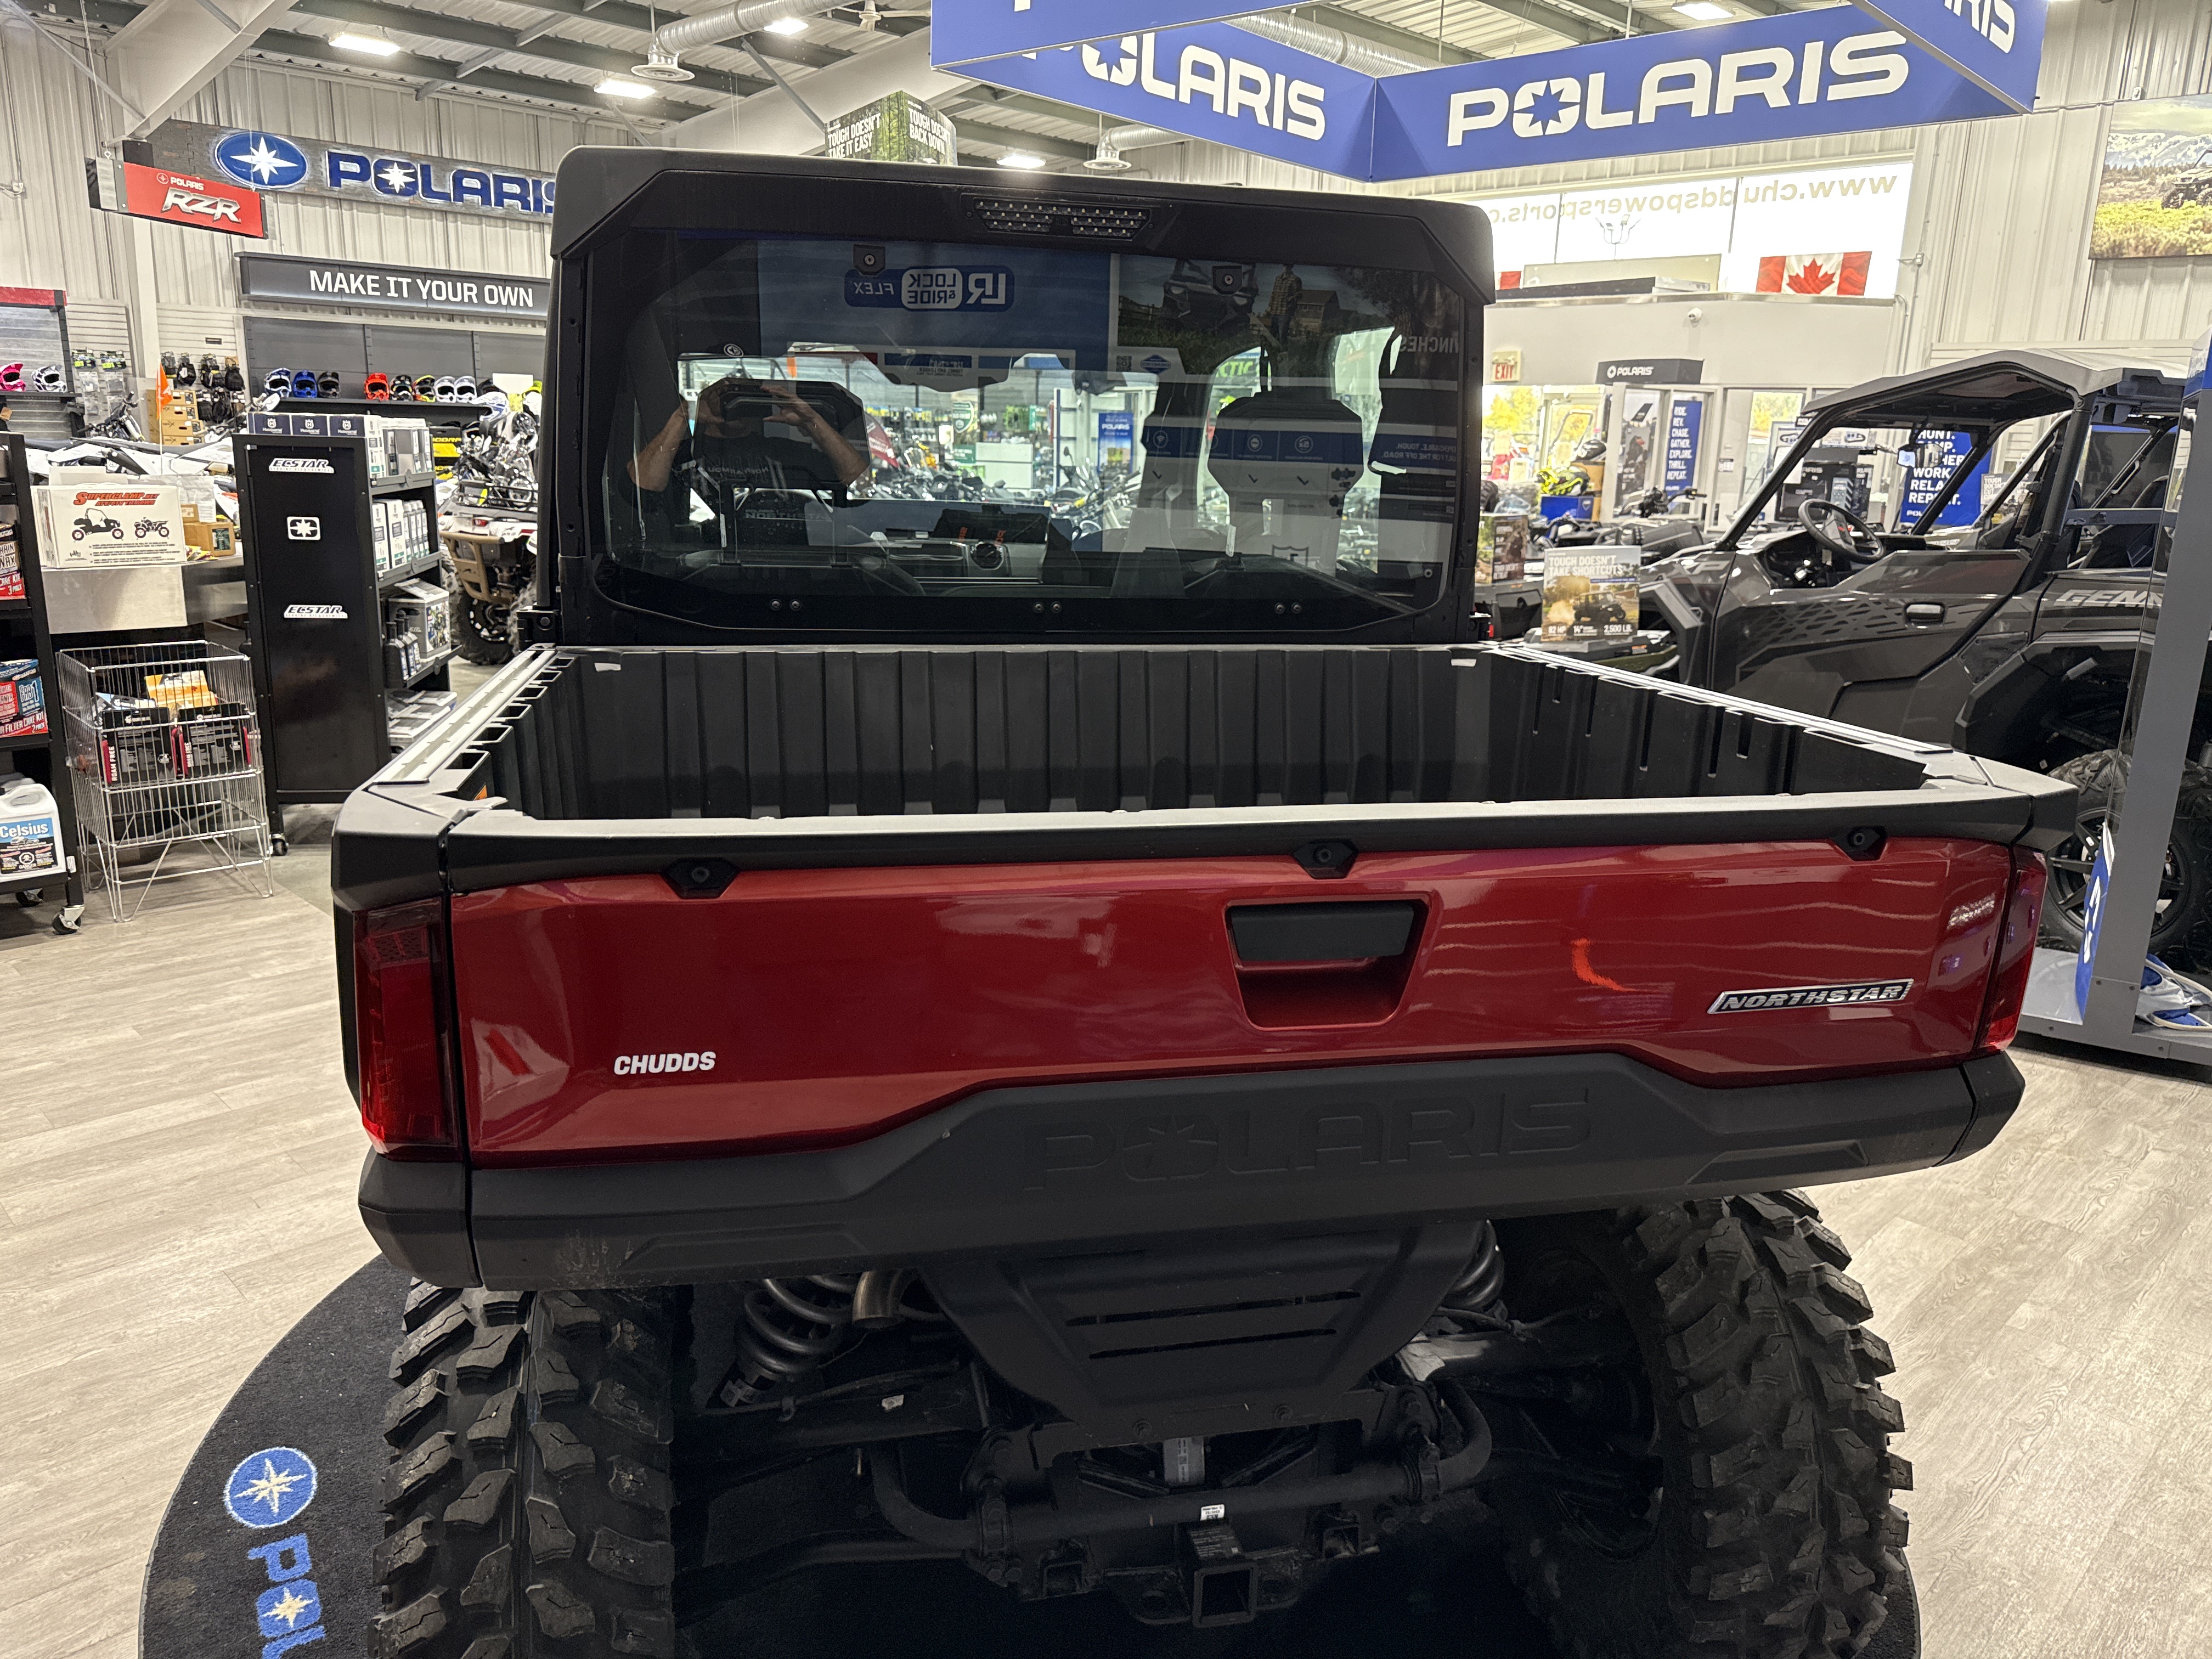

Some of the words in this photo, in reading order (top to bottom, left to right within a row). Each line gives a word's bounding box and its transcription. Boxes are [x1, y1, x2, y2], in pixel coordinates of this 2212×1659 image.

[1022, 32, 1325, 140] OLARIS
[1447, 30, 1909, 147] POLARIS
[827, 126, 850, 149] TOUGH
[850, 112, 881, 137] DOESN'T
[908, 108, 931, 132] TOUGH
[931, 119, 951, 145] DOESN'T
[828, 143, 845, 159] TAKE
[846, 139, 854, 156] IT
[854, 131, 873, 153] EASY
[909, 123, 928, 145] BACK
[928, 133, 946, 155] DOWN
[171, 176, 204, 191] POLARIS
[161, 188, 241, 224] RZR
[309, 270, 381, 296] MAKE
[386, 276, 411, 298] IT
[416, 279, 478, 303] YOUR
[484, 284, 533, 308] OWN
[1215, 361, 1254, 378] CTIC
[1494, 363, 1515, 380] EXIT
[1616, 366, 1654, 376] POLARIS
[1671, 428, 1690, 437] CHASE.
[272, 459, 329, 468] ECSTAR
[1910, 479, 1945, 492] RELA
[1549, 556, 1577, 567] TOUGH
[1578, 555, 1617, 566] DOESN'T
[1549, 567, 1570, 577] TAKE
[1572, 565, 1623, 576] SHORTCUTS
[287, 606, 342, 614] ECSTAR
[1604, 624, 1622, 634] 2,500
[108, 746, 116, 762] FREE
[0, 823, 48, 838] Celsius
[1721, 985, 1903, 1010] NORTHSTAR
[613, 1051, 716, 1075] CHUDDS
[1022, 1088, 1592, 1192] POLARIS
